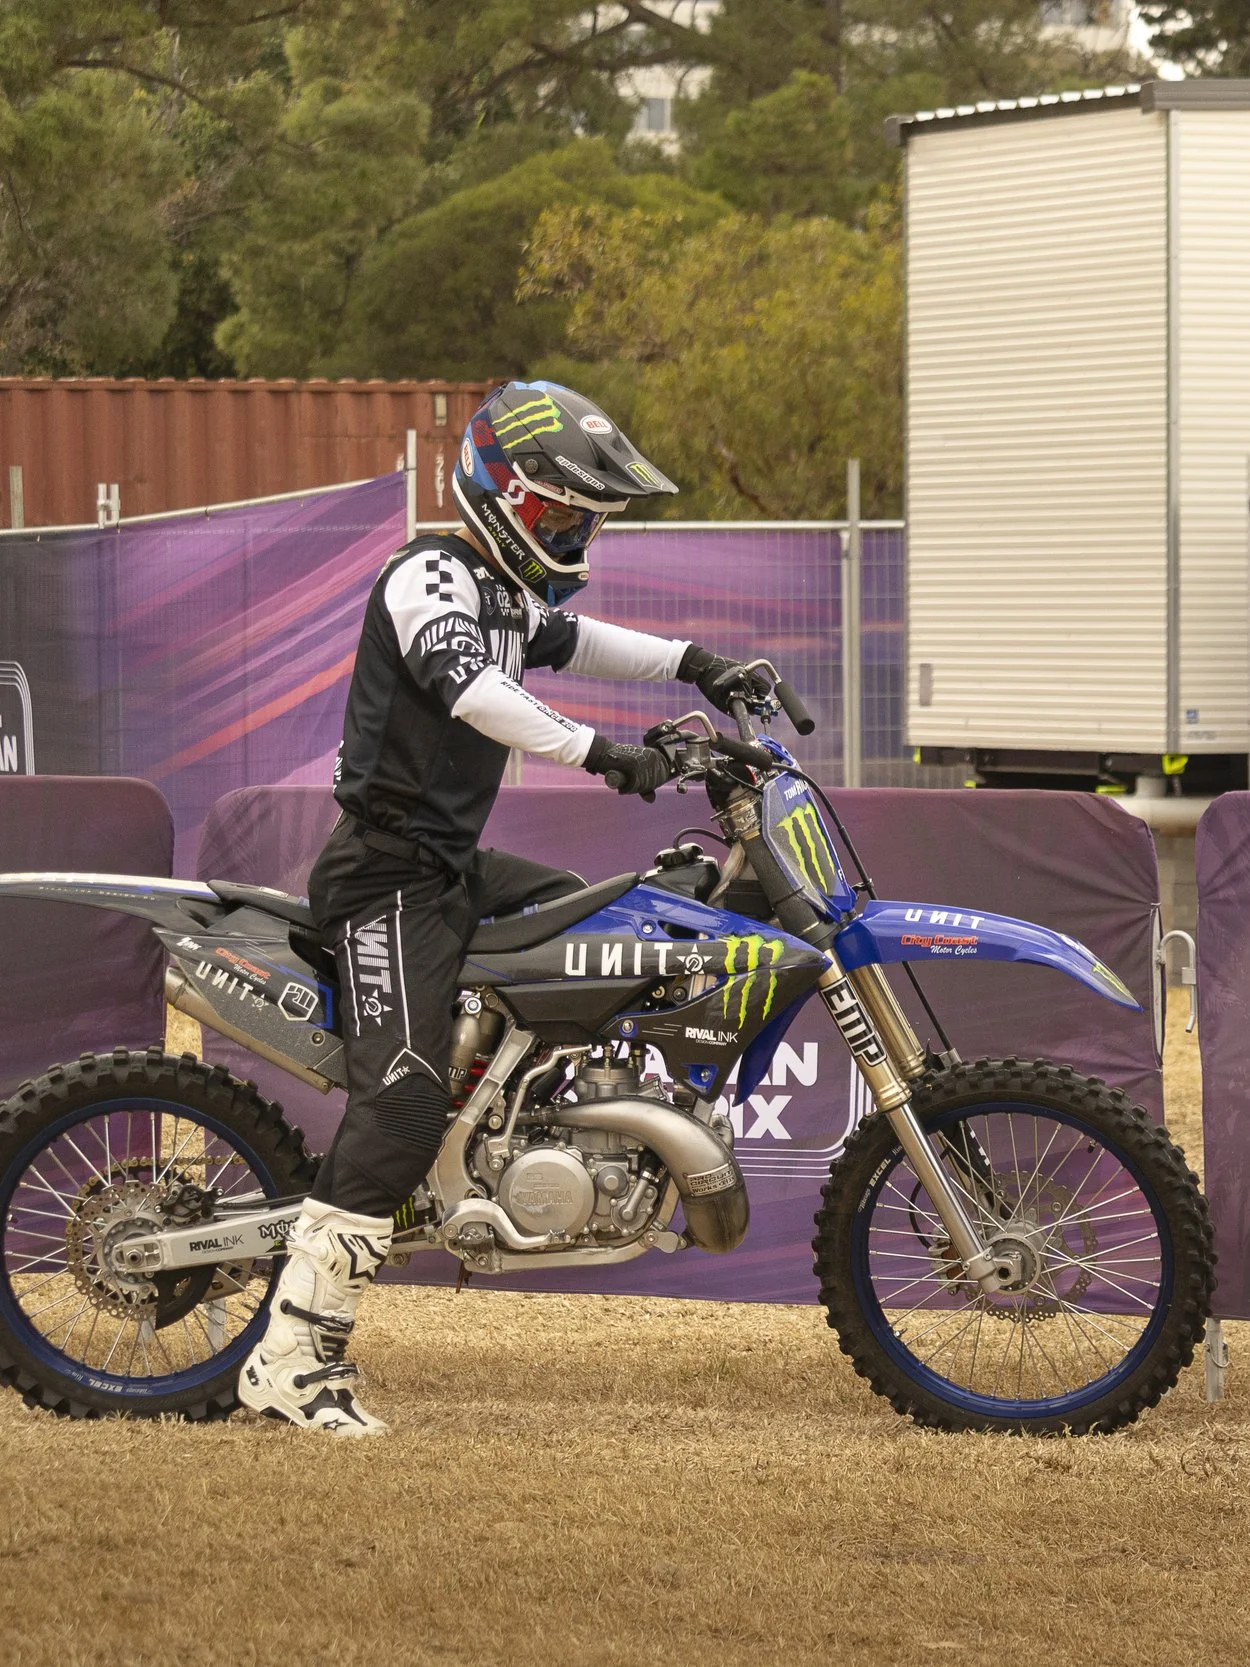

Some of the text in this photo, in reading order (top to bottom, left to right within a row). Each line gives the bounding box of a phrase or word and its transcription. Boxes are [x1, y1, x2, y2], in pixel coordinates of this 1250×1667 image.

[585, 419, 609, 430] BELL
[462, 443, 473, 471] BELL
[555, 455, 606, 491] apdesigns
[784, 785, 799, 801] TOM
[904, 908, 985, 930] UNIT
[901, 934, 932, 948] City
[930, 945, 978, 955] Motor Cycles
[564, 942, 673, 977] UNIT
[195, 960, 254, 1001] UNIT
[685, 1026, 739, 1043] RIVAL INK
[382, 1067, 406, 1086] UNIT
[869, 1158, 892, 1187] EXCEL
[691, 1183, 719, 1195] Works
[189, 1237, 222, 1252] RIVAL
[222, 1234, 245, 1247] INK
[88, 1378, 123, 1393] EXCEL
